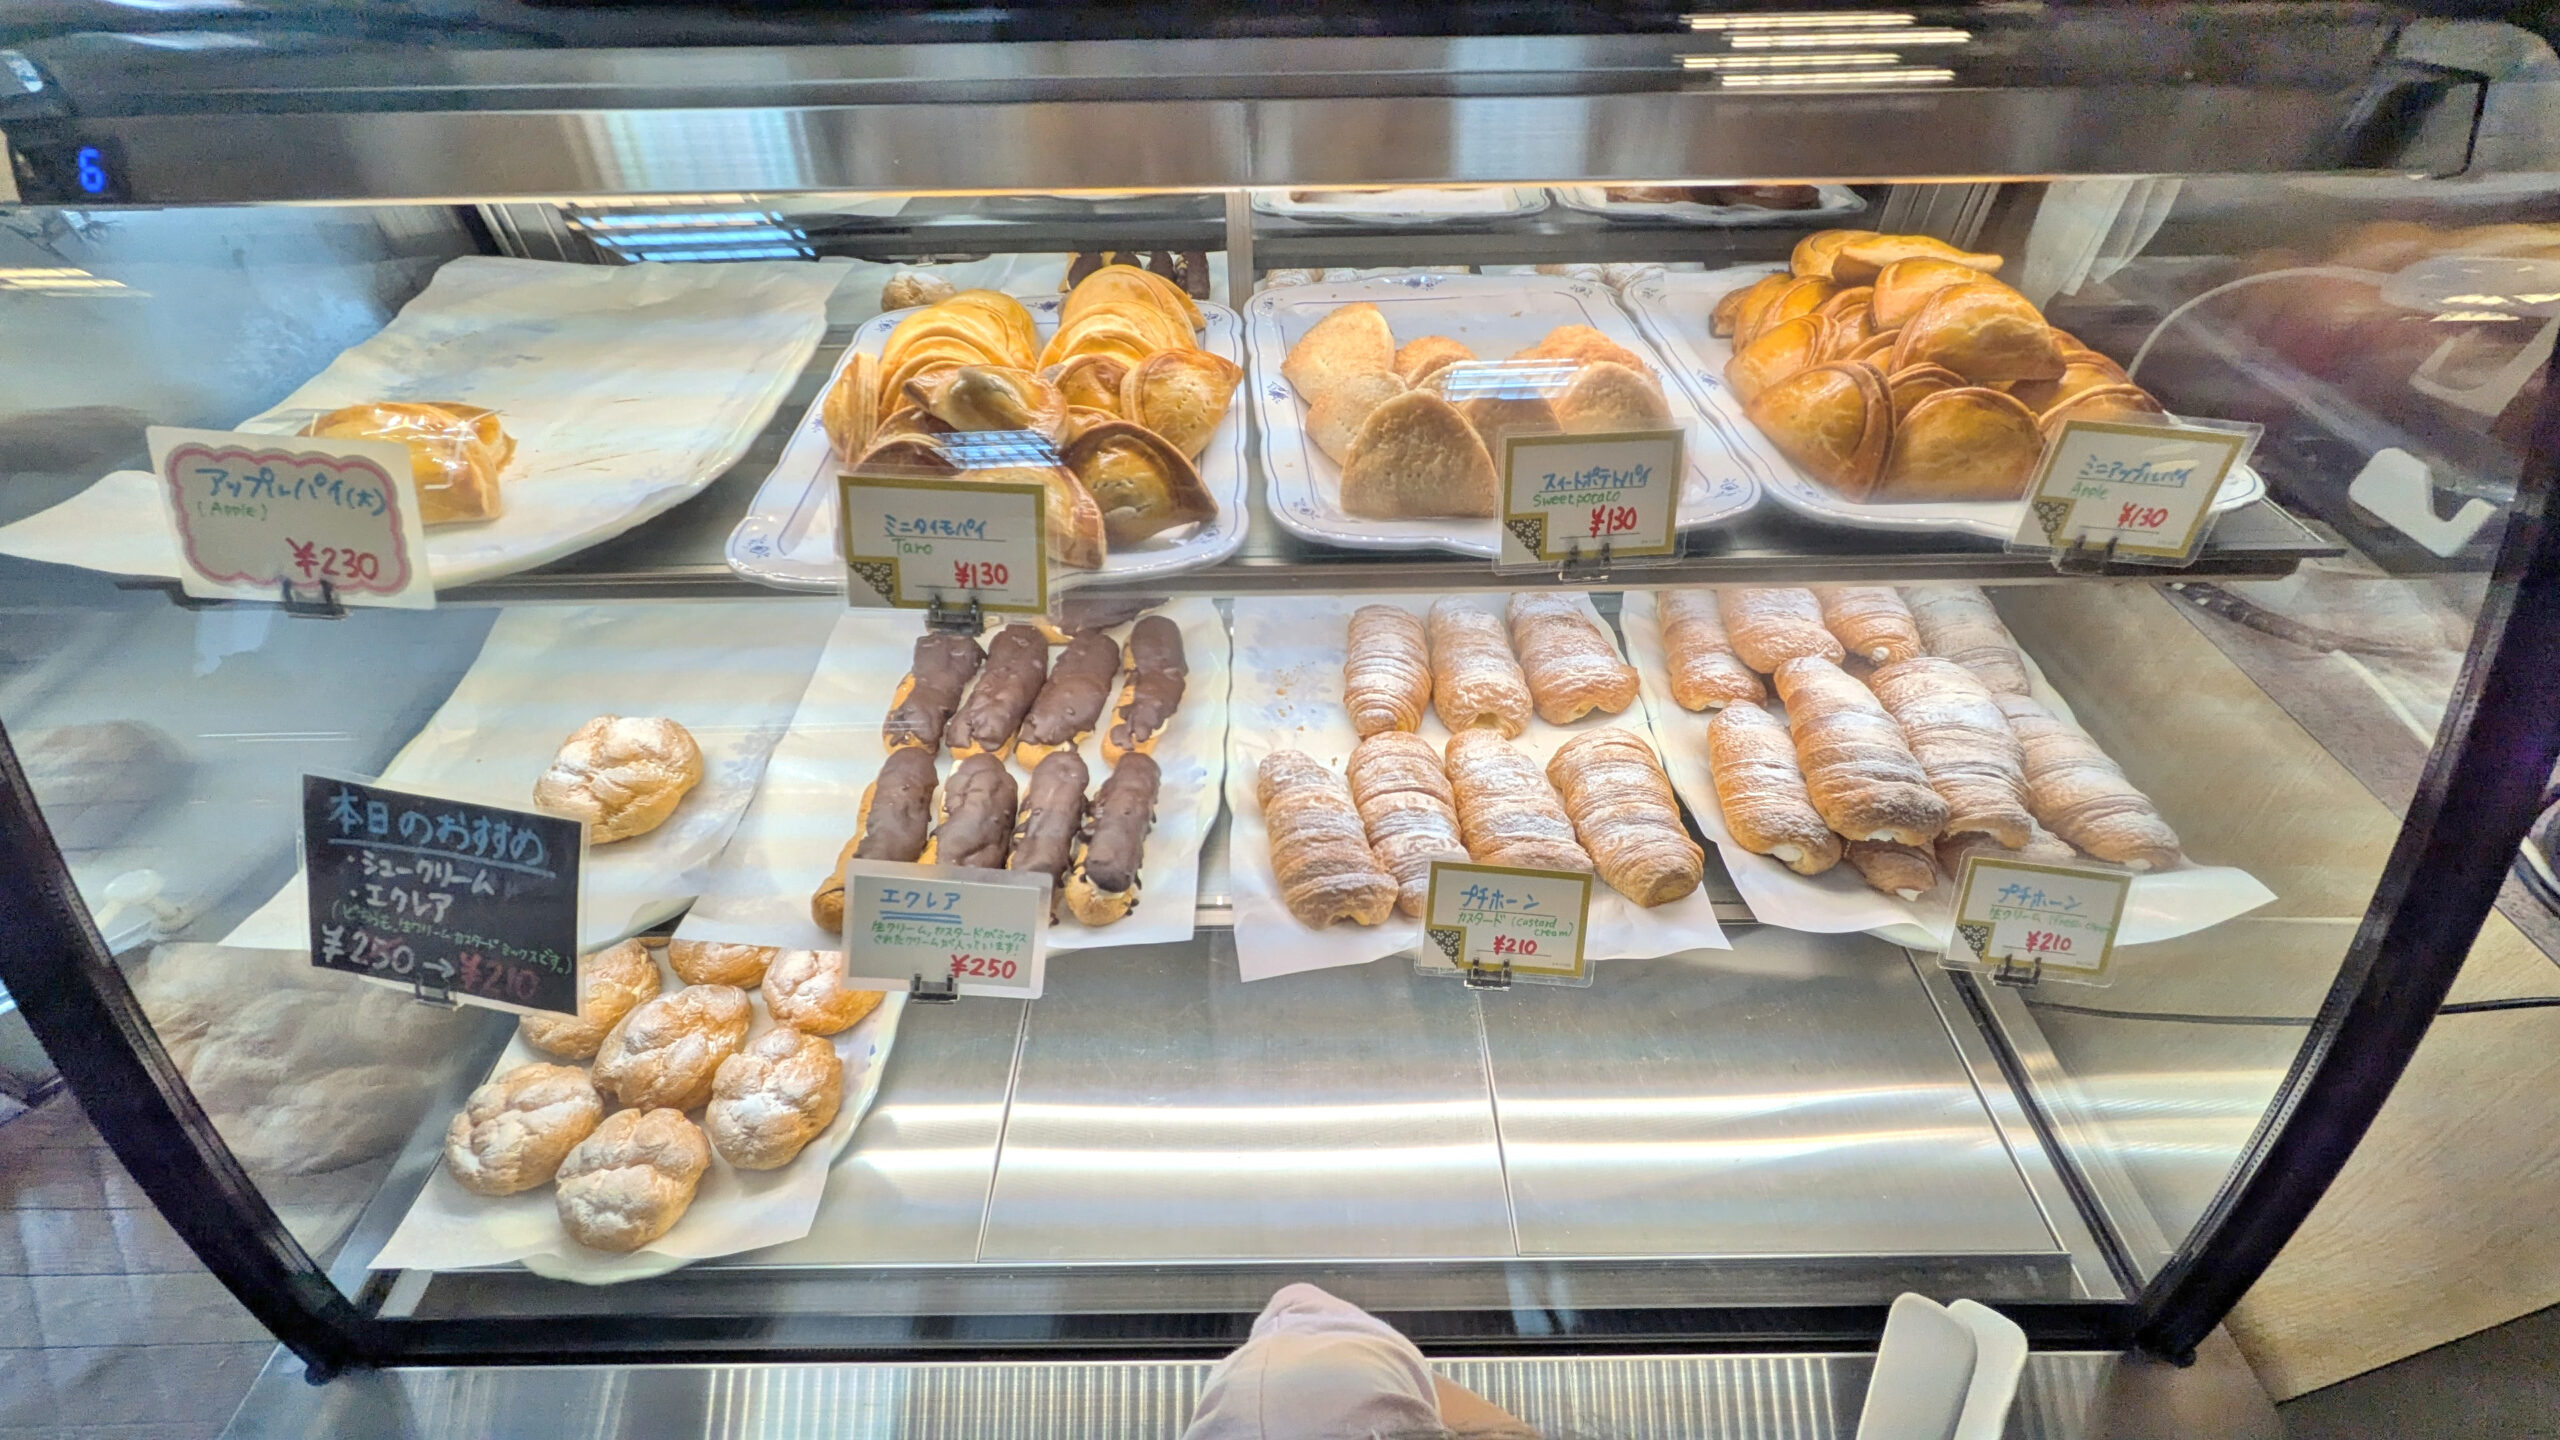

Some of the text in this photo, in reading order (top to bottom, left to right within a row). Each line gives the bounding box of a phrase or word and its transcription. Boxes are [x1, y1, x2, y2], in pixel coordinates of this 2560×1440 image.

[78, 146, 106, 192] 6
[1589, 504, 1637, 538] ¥130
[2118, 502, 2168, 528] ¥130
[286, 537, 379, 580] ¥230
[891, 538, 933, 555] Taro
[954, 560, 1008, 588] ¥130
[328, 787, 544, 866] 本日のおすすめ
[879, 888, 961, 910] エクレア
[1460, 884, 1540, 910] プチホーン
[1998, 884, 2082, 910] プチホーン
[1457, 911, 1506, 928] カスタード
[322, 925, 414, 974] ¥250
[1493, 934, 1538, 955] ¥210
[2025, 930, 2072, 953] ¥210
[950, 954, 1017, 979] ¥250
